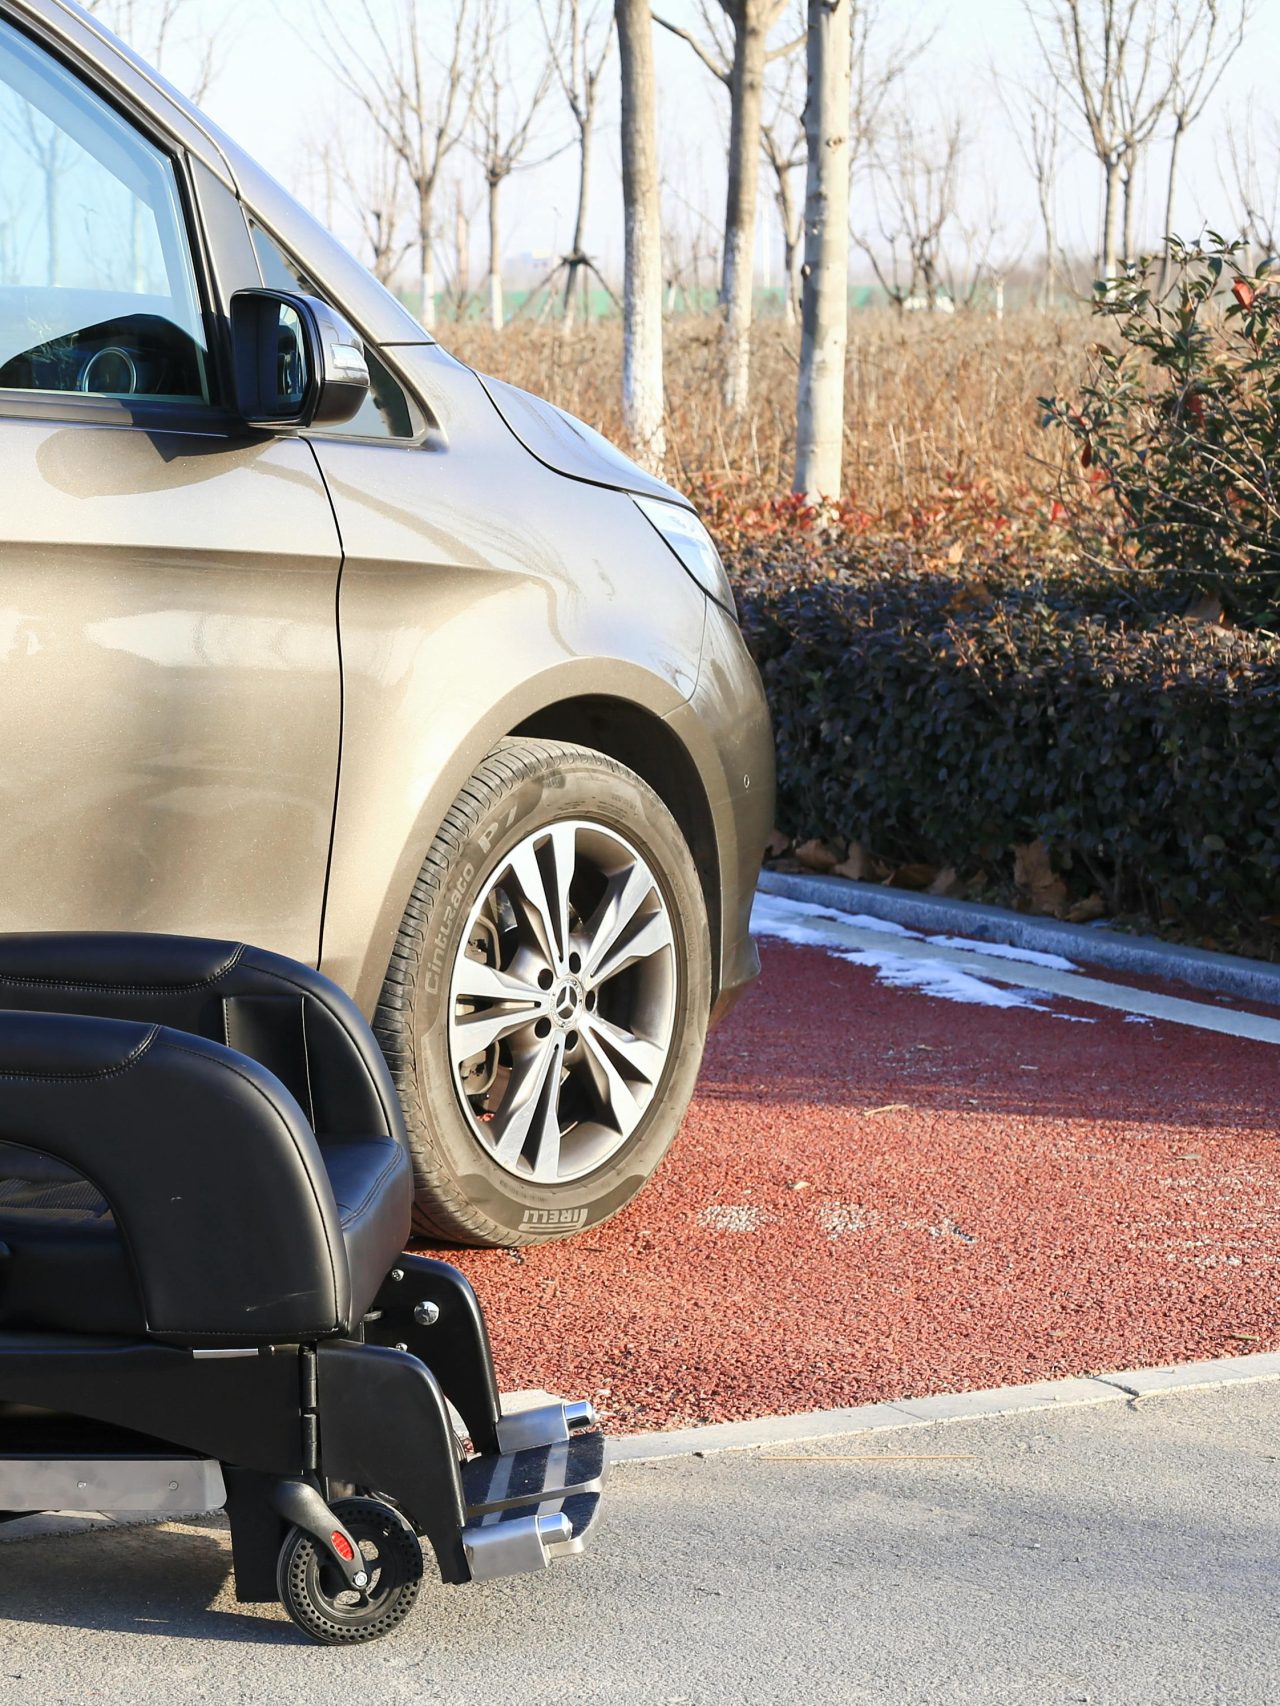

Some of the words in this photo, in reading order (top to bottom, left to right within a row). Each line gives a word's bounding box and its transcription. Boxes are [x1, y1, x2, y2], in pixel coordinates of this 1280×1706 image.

[424, 863, 475, 995] Cinturato
[477, 805, 517, 854] P7
[518, 1208, 589, 1231] PIRELLI
